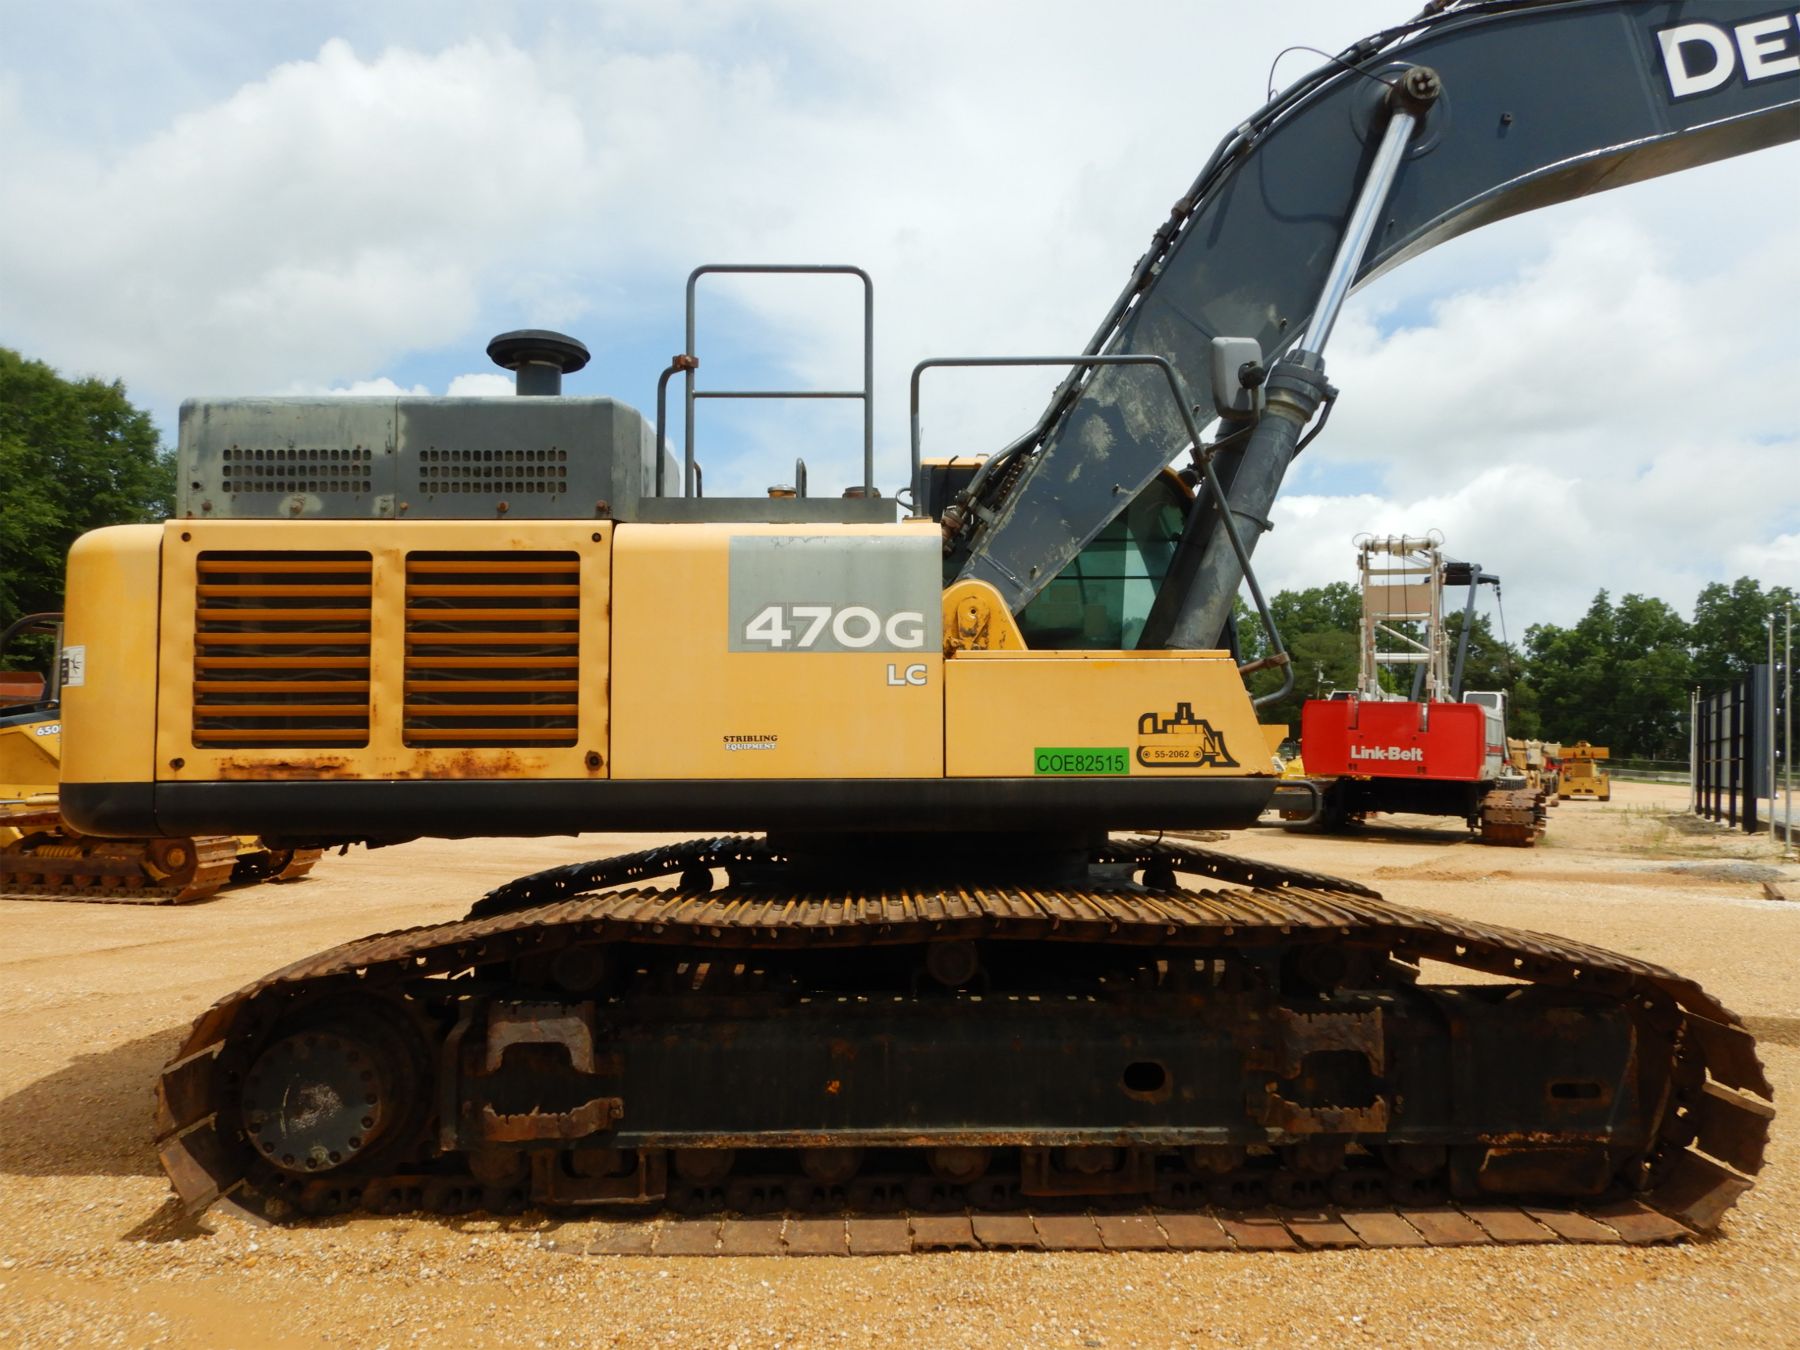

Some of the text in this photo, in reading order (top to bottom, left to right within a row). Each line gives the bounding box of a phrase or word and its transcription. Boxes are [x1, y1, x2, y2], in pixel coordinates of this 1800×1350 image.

[1656, 12, 1800, 98] DE
[745, 605, 925, 648] 470G
[887, 664, 927, 686] LC
[35, 724, 61, 736] 650
[722, 735, 778, 743] STRIBLING
[724, 743, 777, 751] EQUIPMENT
[1154, 750, 1190, 758] 55-2062
[1350, 744, 1424, 762] Link-Belt
[1036, 754, 1124, 772] COE82515
